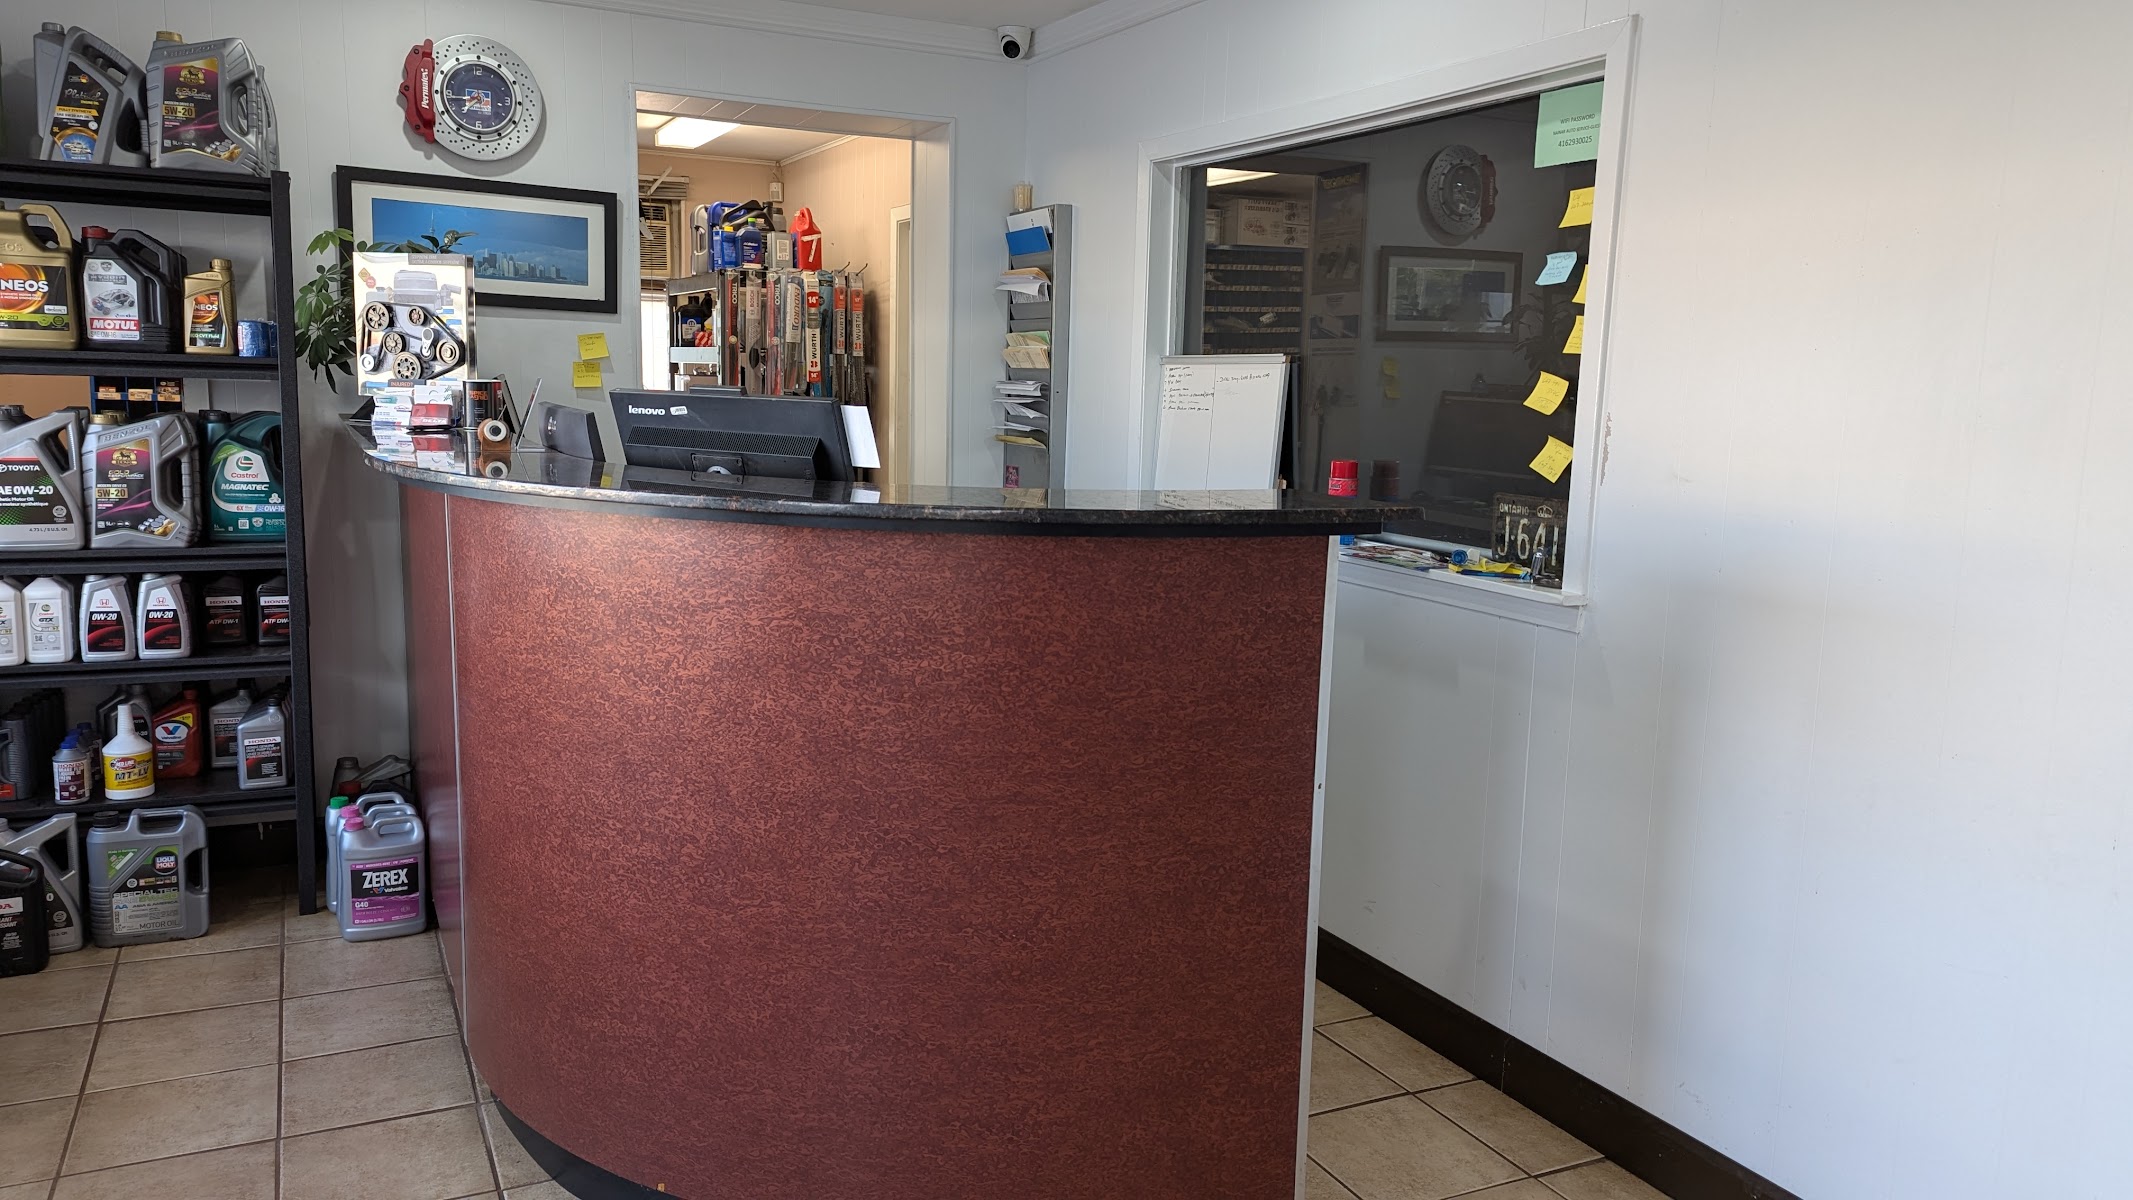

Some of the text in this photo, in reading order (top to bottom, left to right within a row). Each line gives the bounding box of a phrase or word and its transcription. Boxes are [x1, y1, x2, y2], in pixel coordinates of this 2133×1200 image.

[472, 66, 483, 76] 12
[504, 96, 511, 106] 3
[164, 107, 193, 116] 5W-20
[1571, 113, 1595, 122] PASSWORD
[475, 120, 482, 129] 6
[92, 320, 137, 330] MOTUL
[628, 404, 666, 416] lenovo
[13, 485, 53, 495] 0W-20
[220, 483, 270, 491] MAGNATEC
[97, 488, 126, 498] 5W-20
[1499, 502, 1530, 516] ONTARIO
[91, 613, 118, 621] 0W-20
[148, 611, 174, 619] 0W-20
[115, 767, 149, 781] MT-LV
[156, 861, 177, 869] MOLY
[362, 868, 409, 889] ZEREX
[113, 889, 155, 899] SPECIAL
[384, 885, 408, 893] Valvoline
[140, 921, 166, 929] MOTOR
